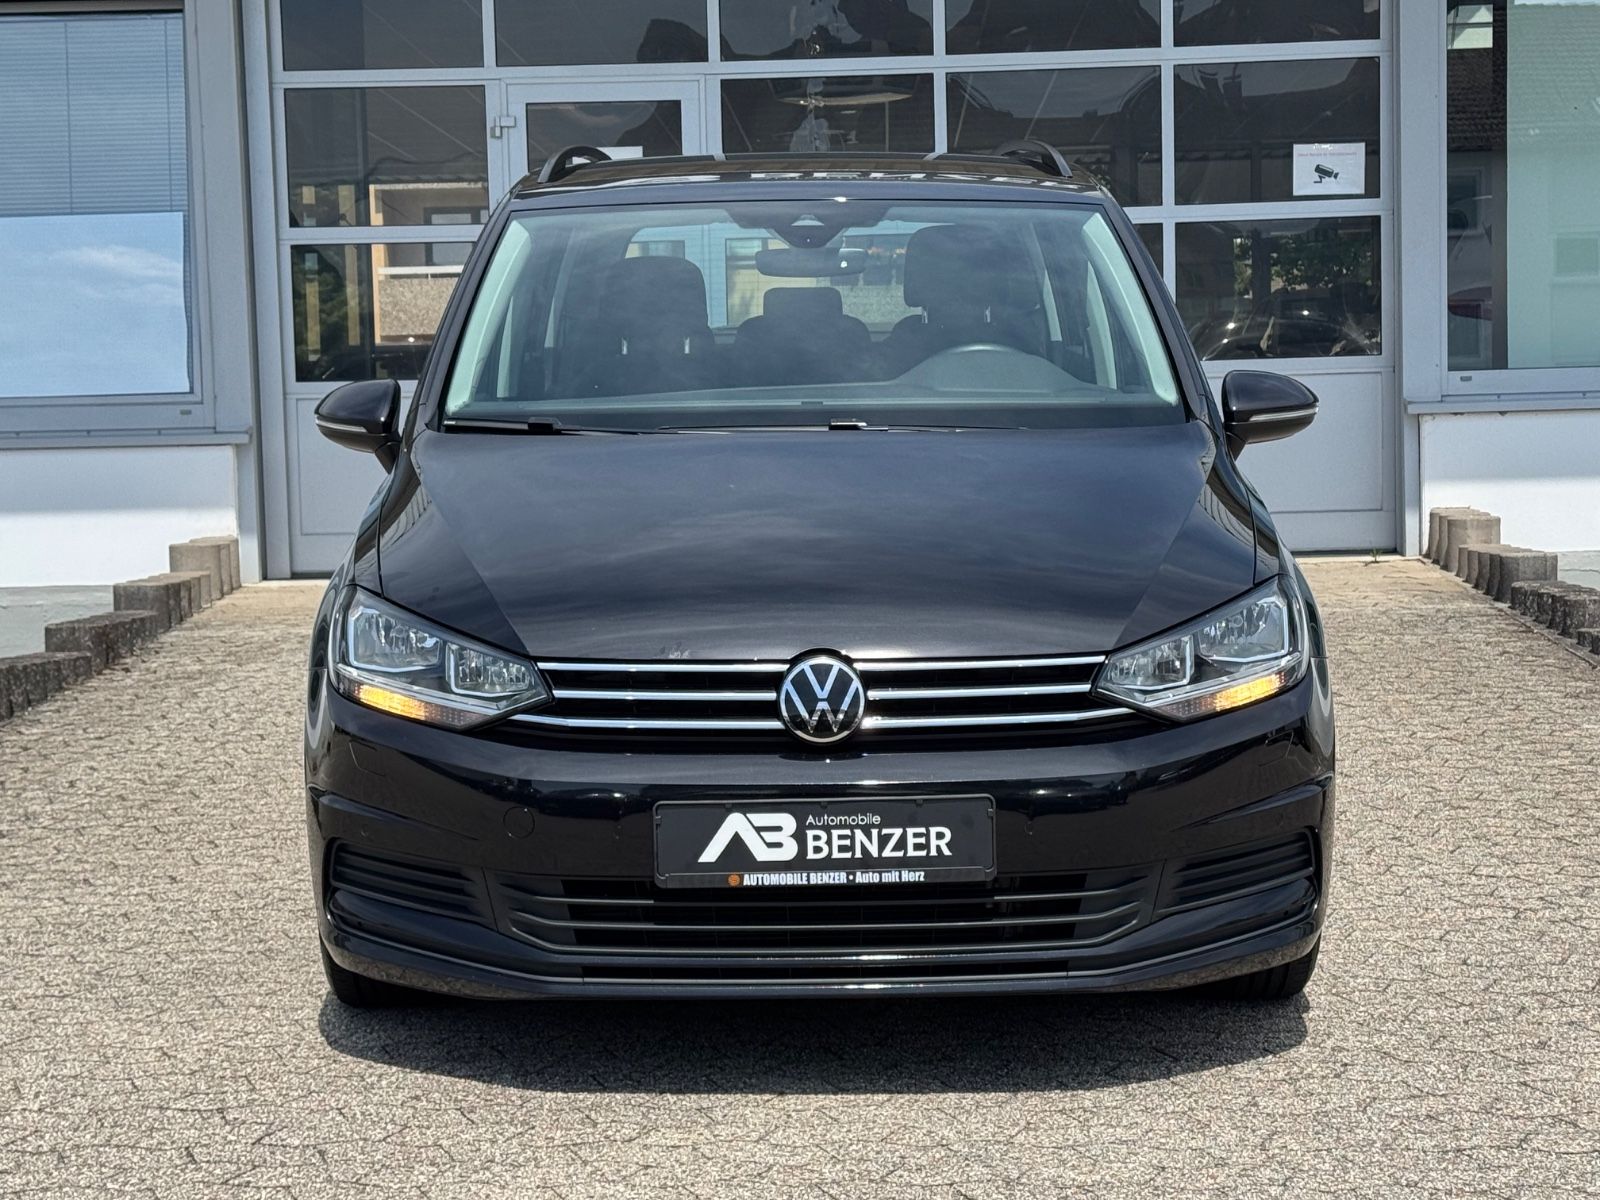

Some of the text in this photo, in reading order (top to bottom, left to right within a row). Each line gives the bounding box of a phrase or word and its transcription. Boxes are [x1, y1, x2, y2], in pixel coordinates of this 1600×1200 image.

[805, 813, 881, 826] Automobile
[805, 826, 953, 860] BENZER
[743, 869, 925, 886] AUTOMOBILE BENZER Auto mit Herz
